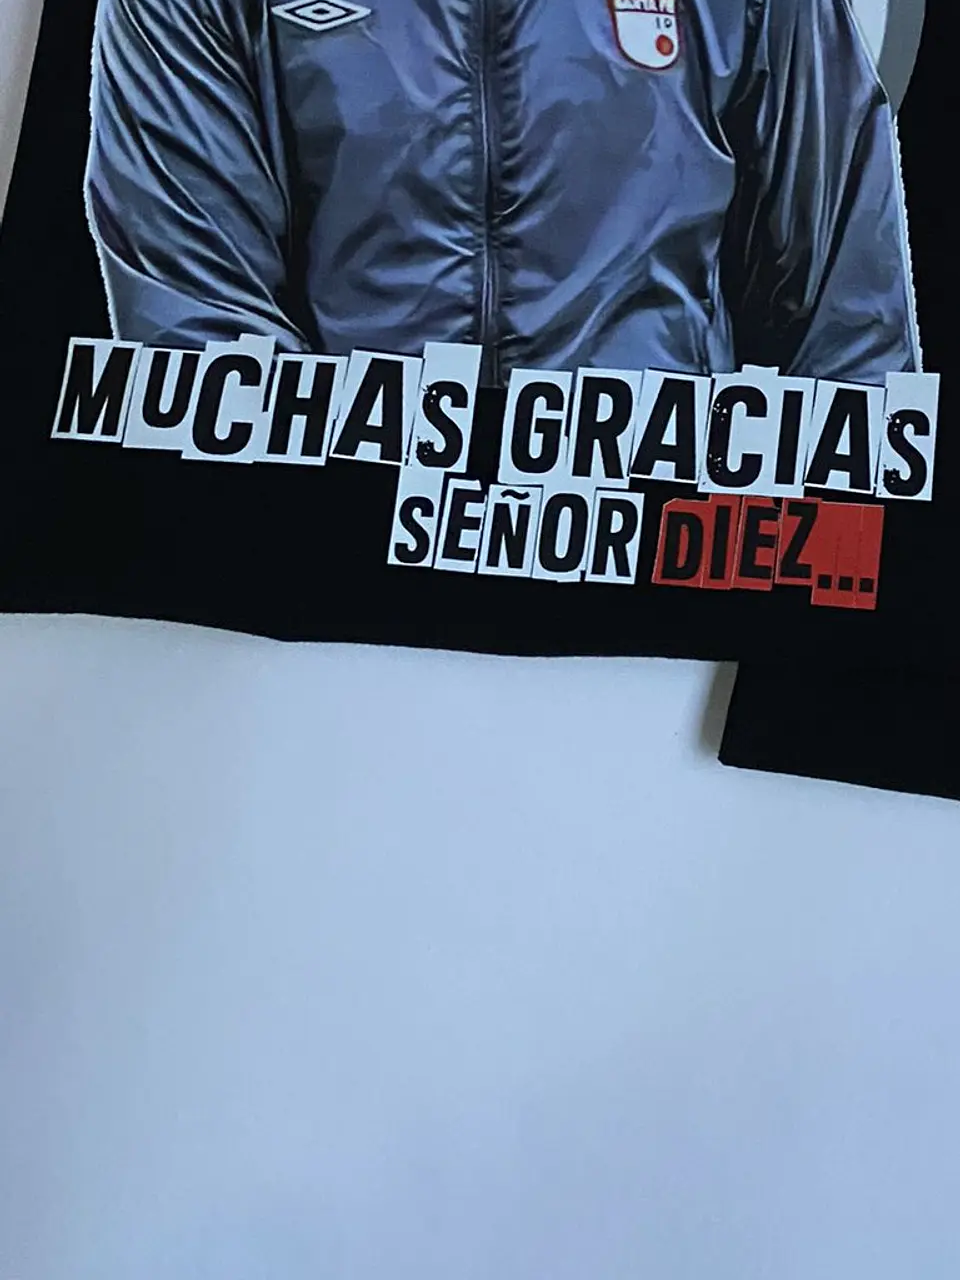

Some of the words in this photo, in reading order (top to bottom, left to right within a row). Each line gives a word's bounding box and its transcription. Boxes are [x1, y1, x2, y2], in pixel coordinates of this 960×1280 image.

[57, 343, 469, 469] MUCHAS
[509, 376, 931, 497] GRACIAS
[393, 487, 638, 579] SEÑOR
